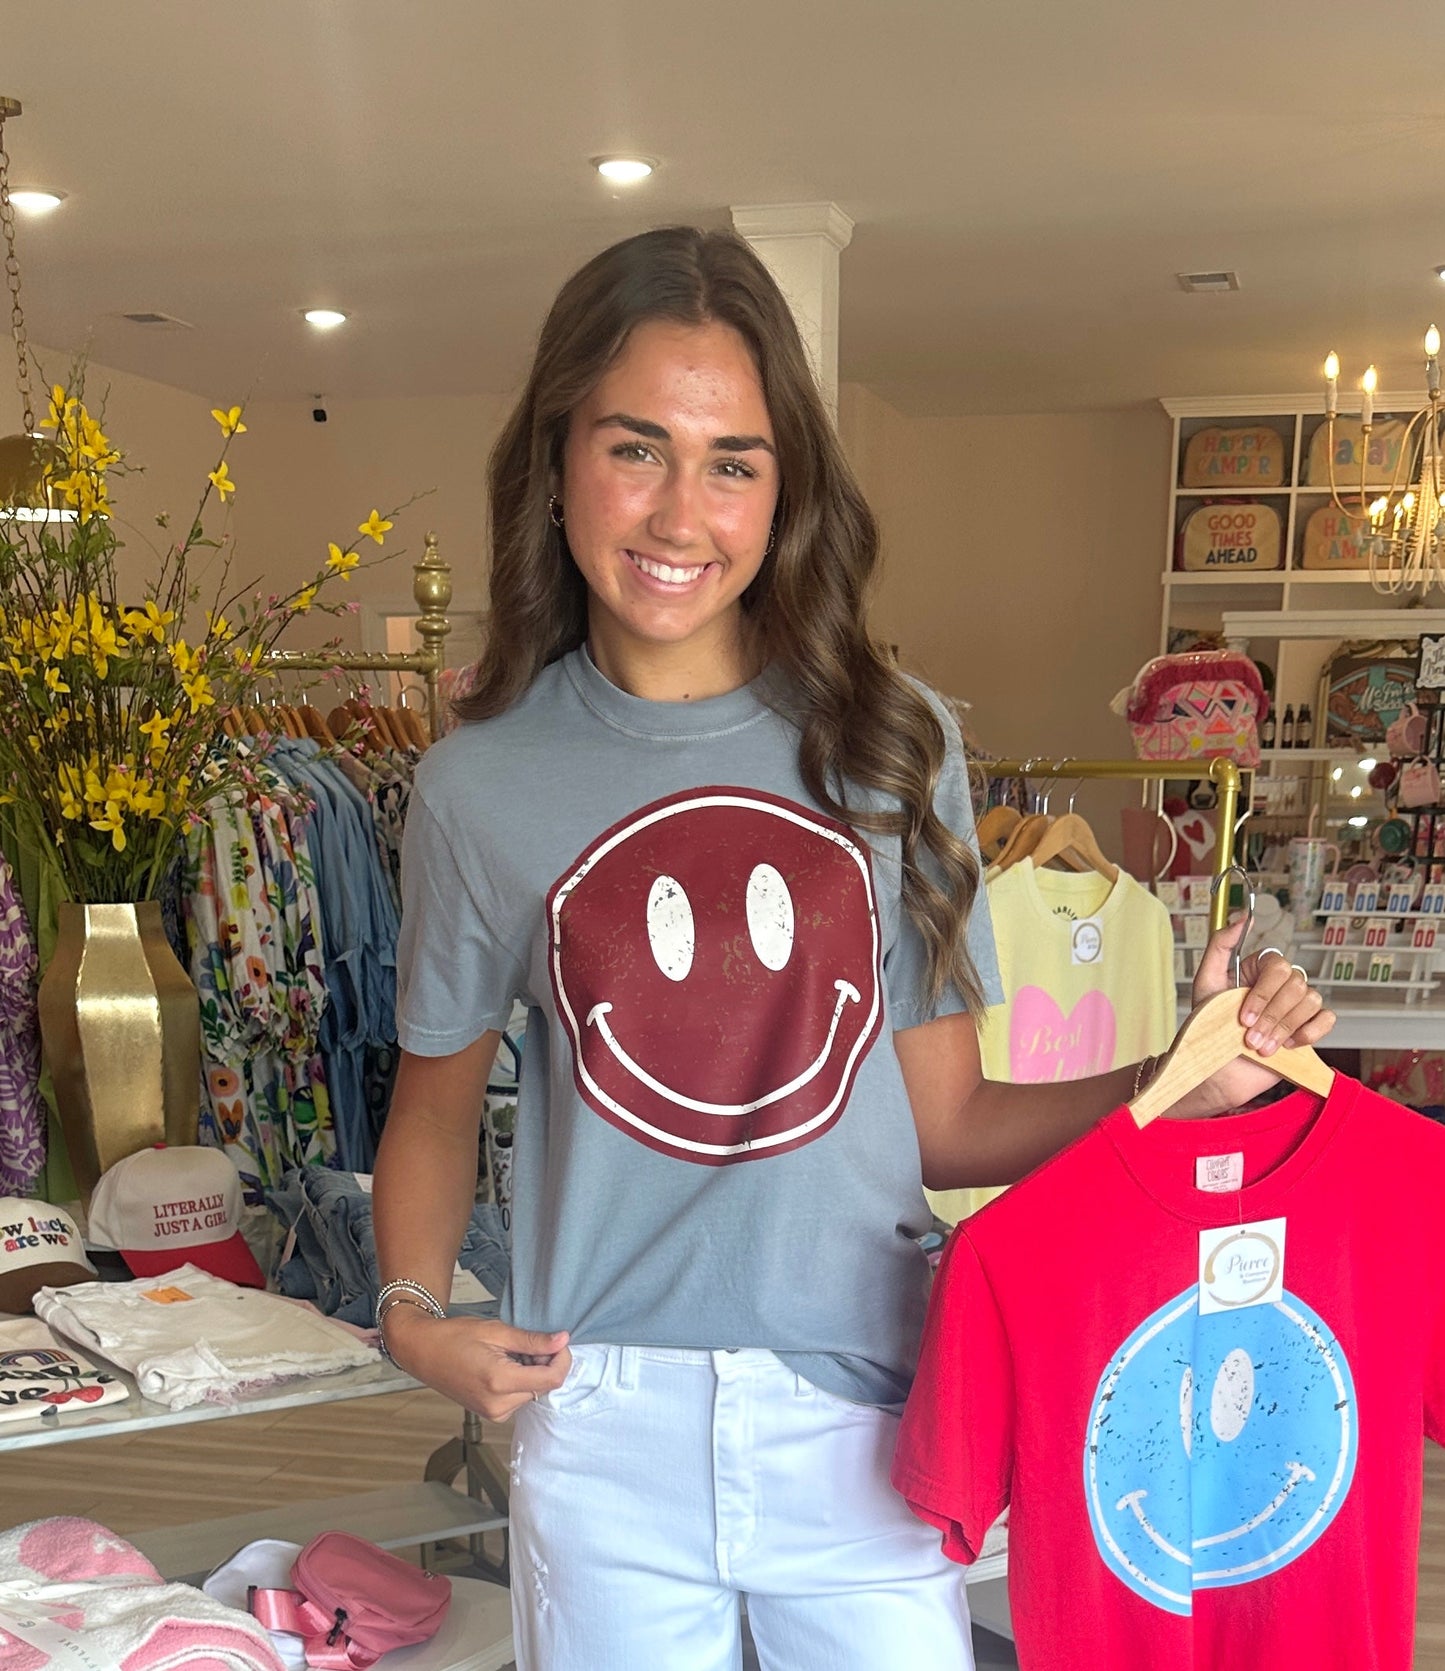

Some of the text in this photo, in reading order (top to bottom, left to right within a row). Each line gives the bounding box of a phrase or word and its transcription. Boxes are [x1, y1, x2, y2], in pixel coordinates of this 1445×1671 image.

[1208, 513, 1257, 530] GOOD
[1210, 531, 1253, 548] TIMES
[1205, 547, 1258, 564] AHEAD
[1020, 1023, 1083, 1057] Best
[153, 1193, 224, 1219] LITERALLY
[28, 1216, 75, 1238] lucky
[154, 1210, 228, 1238] JUST A GIRL
[5, 1233, 69, 1252] are we
